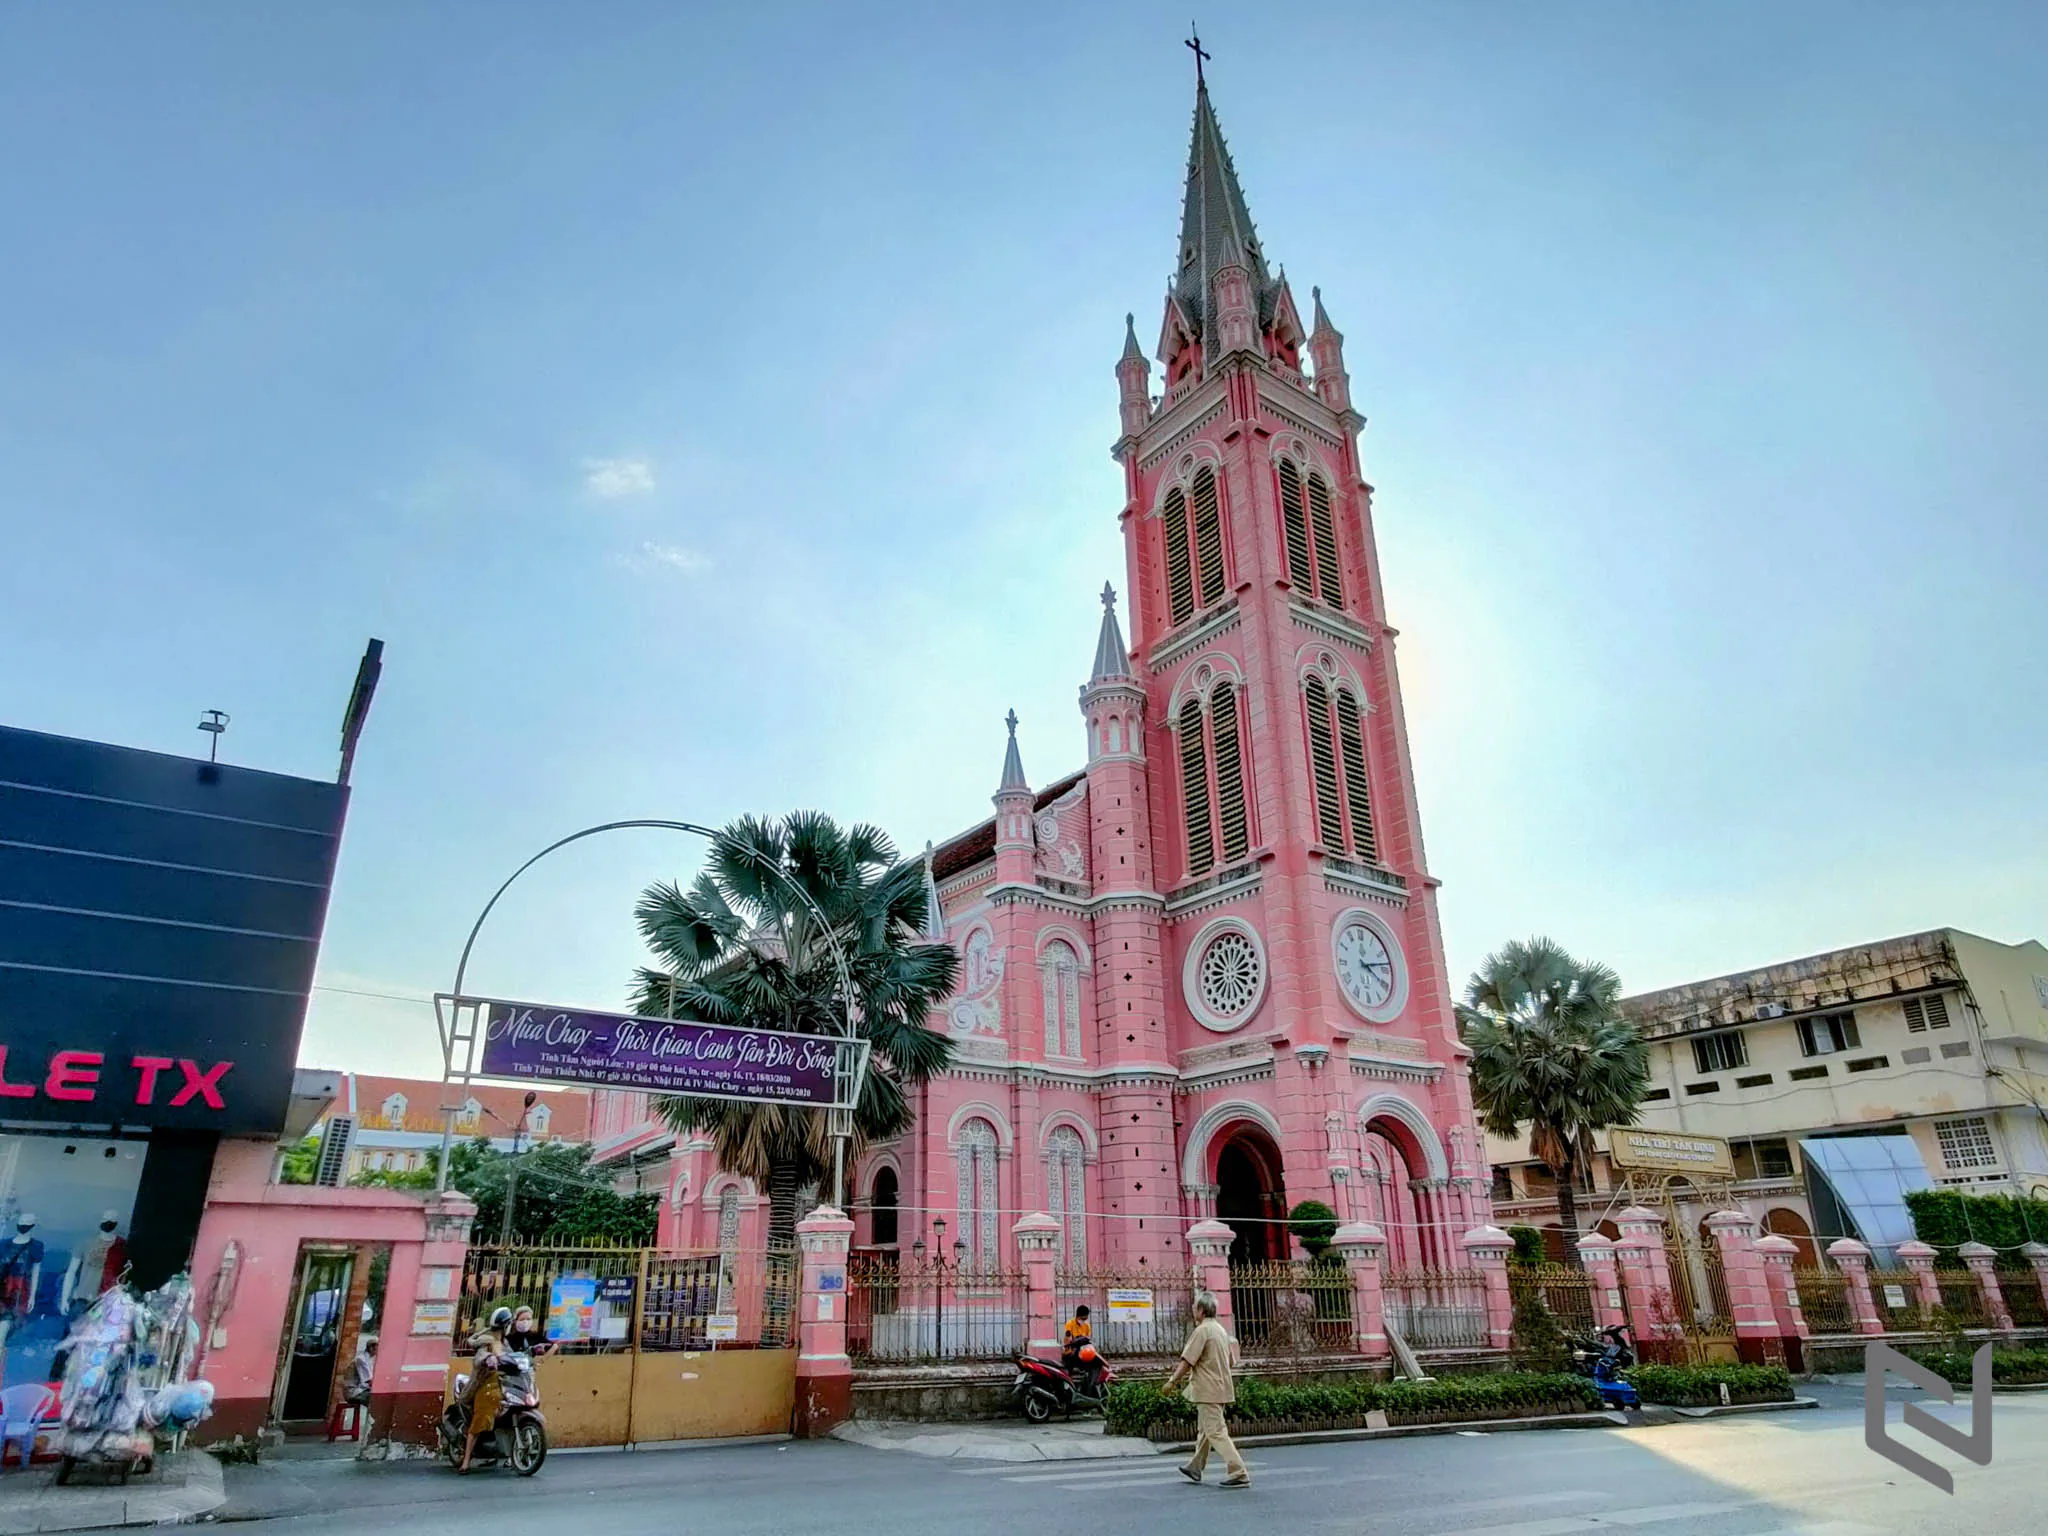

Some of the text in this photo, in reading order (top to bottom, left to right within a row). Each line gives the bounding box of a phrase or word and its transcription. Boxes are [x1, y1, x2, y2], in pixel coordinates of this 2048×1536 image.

[487, 1007, 545, 1048] Mùa
[544, 1014, 592, 1053] Chay
[610, 1019, 651, 1057] Thời
[652, 1025, 694, 1059] Gian
[694, 1030, 735, 1061] Canh
[733, 1033, 767, 1070] Tân
[765, 1036, 796, 1068] Đời
[795, 1040, 836, 1078] Sống
[131, 1055, 235, 1110] TX
[596, 1070, 606, 1080] 07
[620, 1072, 631, 1082] 30
[684, 1078, 691, 1087] &
[693, 1079, 703, 1088] IV
[626, 1060, 635, 1069] 19
